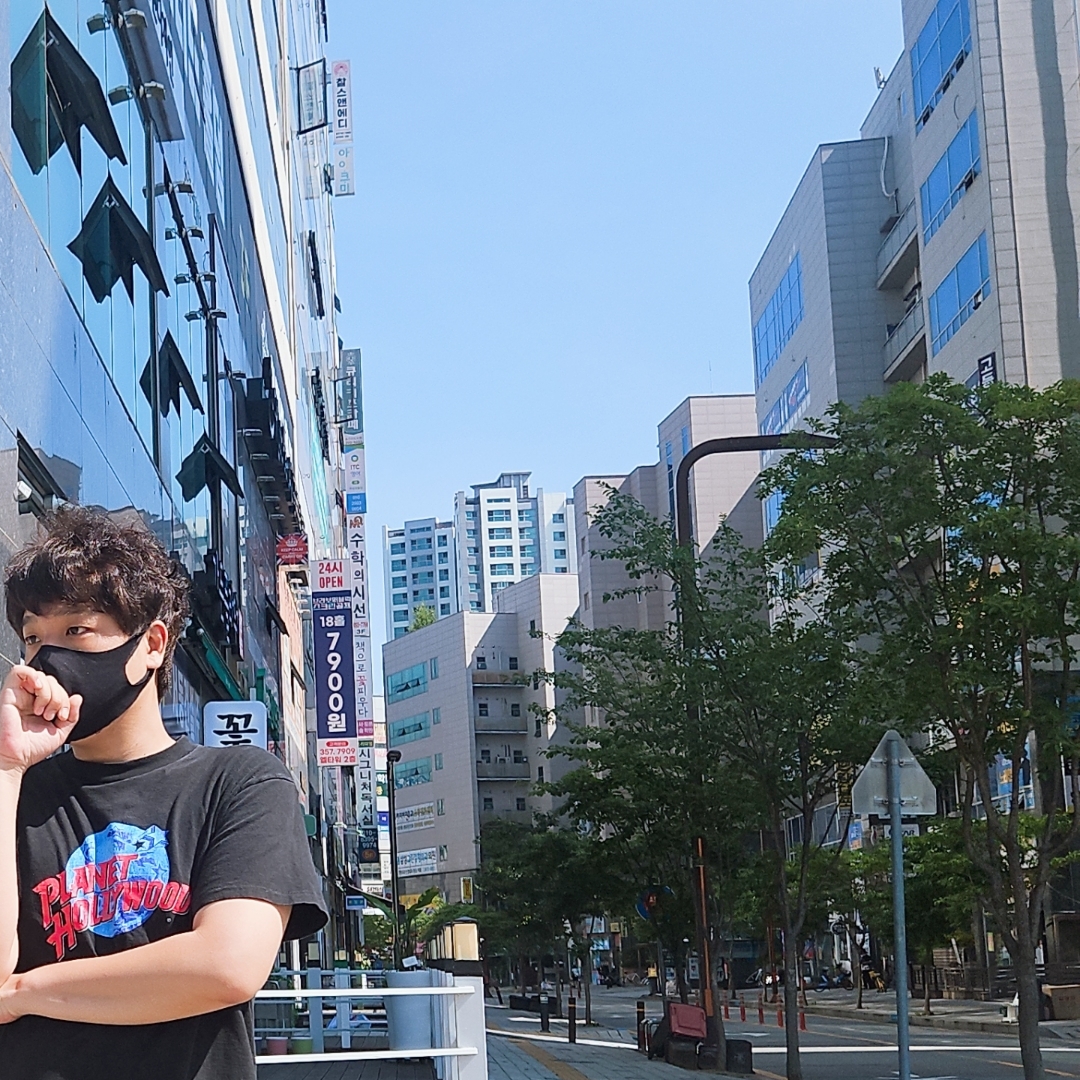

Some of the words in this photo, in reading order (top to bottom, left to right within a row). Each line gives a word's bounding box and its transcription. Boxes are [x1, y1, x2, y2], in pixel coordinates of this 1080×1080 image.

[319, 561, 343, 575] 24시
[319, 575, 343, 589] OPEN
[326, 632, 347, 733] 7900원
[32, 853, 139, 930] PLANET
[46, 879, 192, 962] HOLLYWOOD
